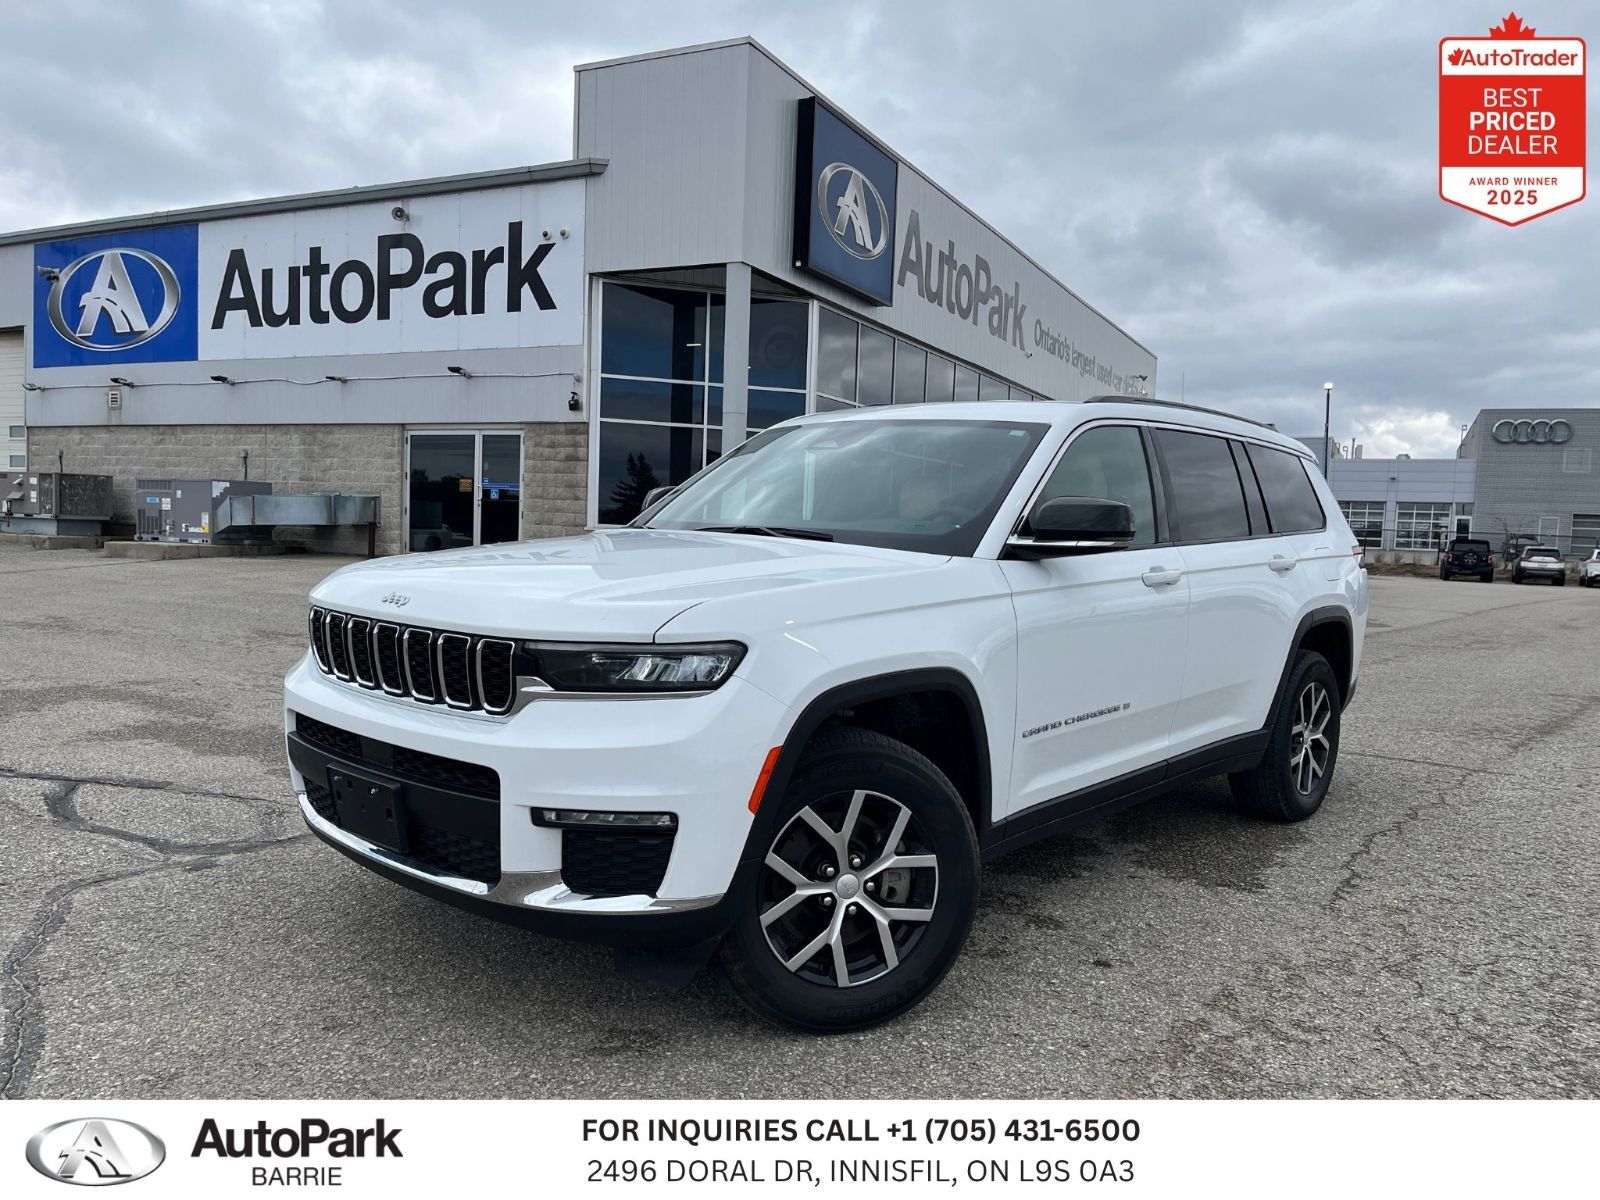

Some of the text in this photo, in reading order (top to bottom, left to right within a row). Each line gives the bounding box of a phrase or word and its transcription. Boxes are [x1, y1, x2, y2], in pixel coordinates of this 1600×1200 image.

[211, 220, 557, 330] AutoPark
[897, 209, 1028, 352] AutoPark
[1034, 318, 1071, 364] Ontario's
[1071, 341, 1096, 378] largest
[382, 591, 411, 608] Jeep
[1022, 720, 1063, 739] GRAND
[1064, 704, 1121, 726] CHEROKEE
